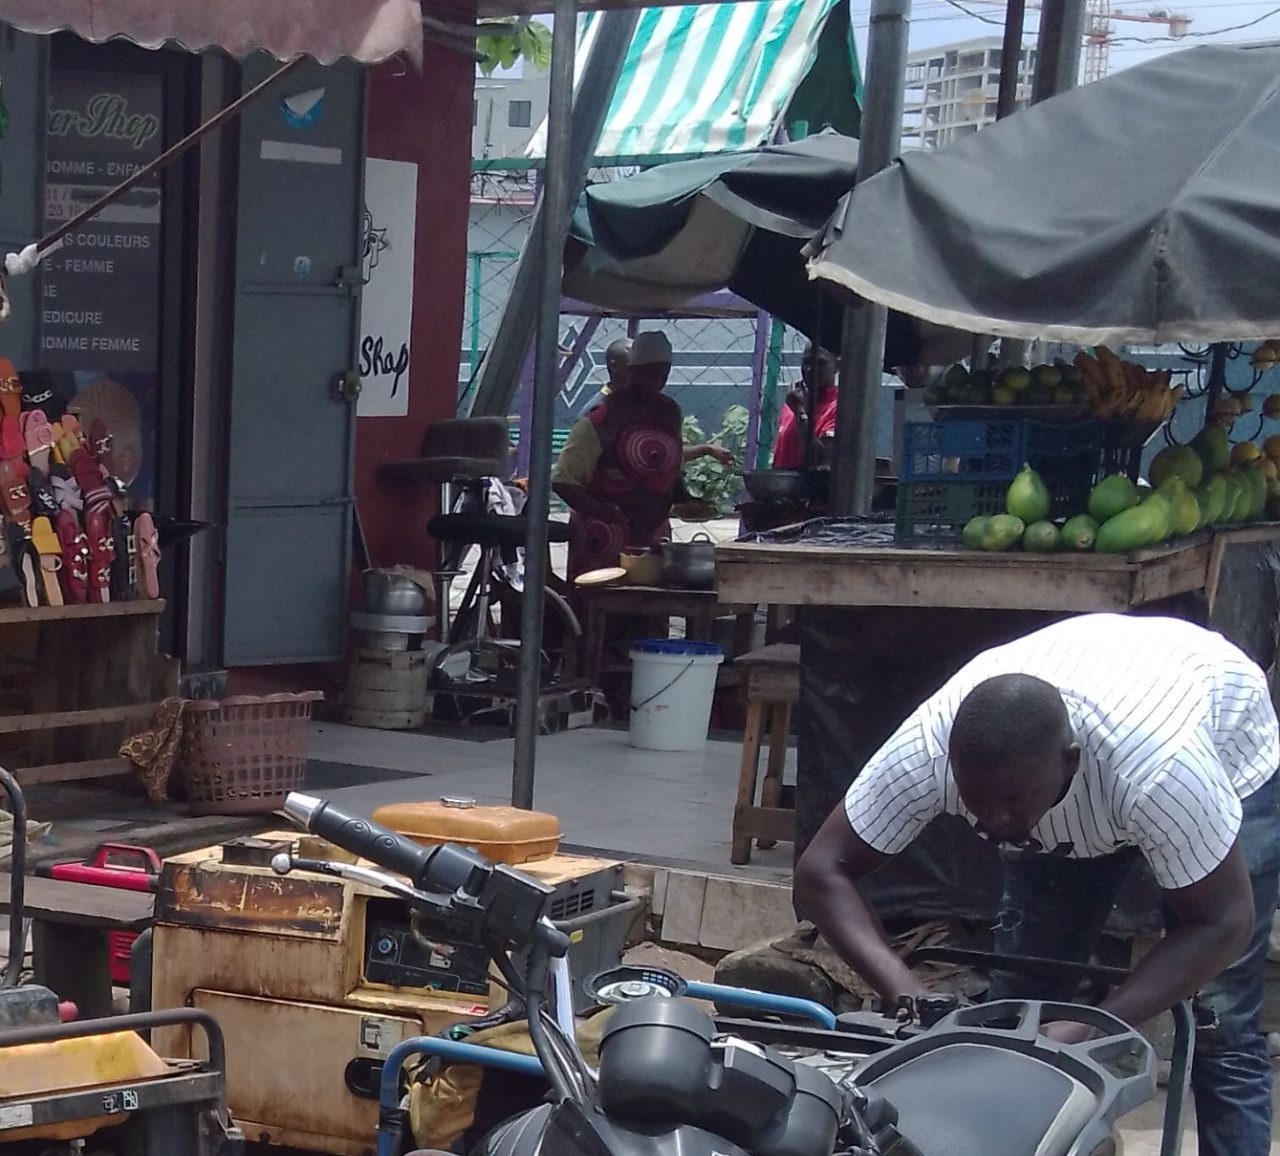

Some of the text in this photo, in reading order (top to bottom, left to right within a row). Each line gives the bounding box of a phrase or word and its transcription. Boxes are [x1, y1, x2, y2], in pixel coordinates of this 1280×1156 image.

[77, 93, 159, 149] Shop
[76, 233, 151, 249] COULEURS
[65, 259, 115, 273] FEMME
[91, 338, 141, 352] FEMME
[360, 336, 408, 399] Shop
